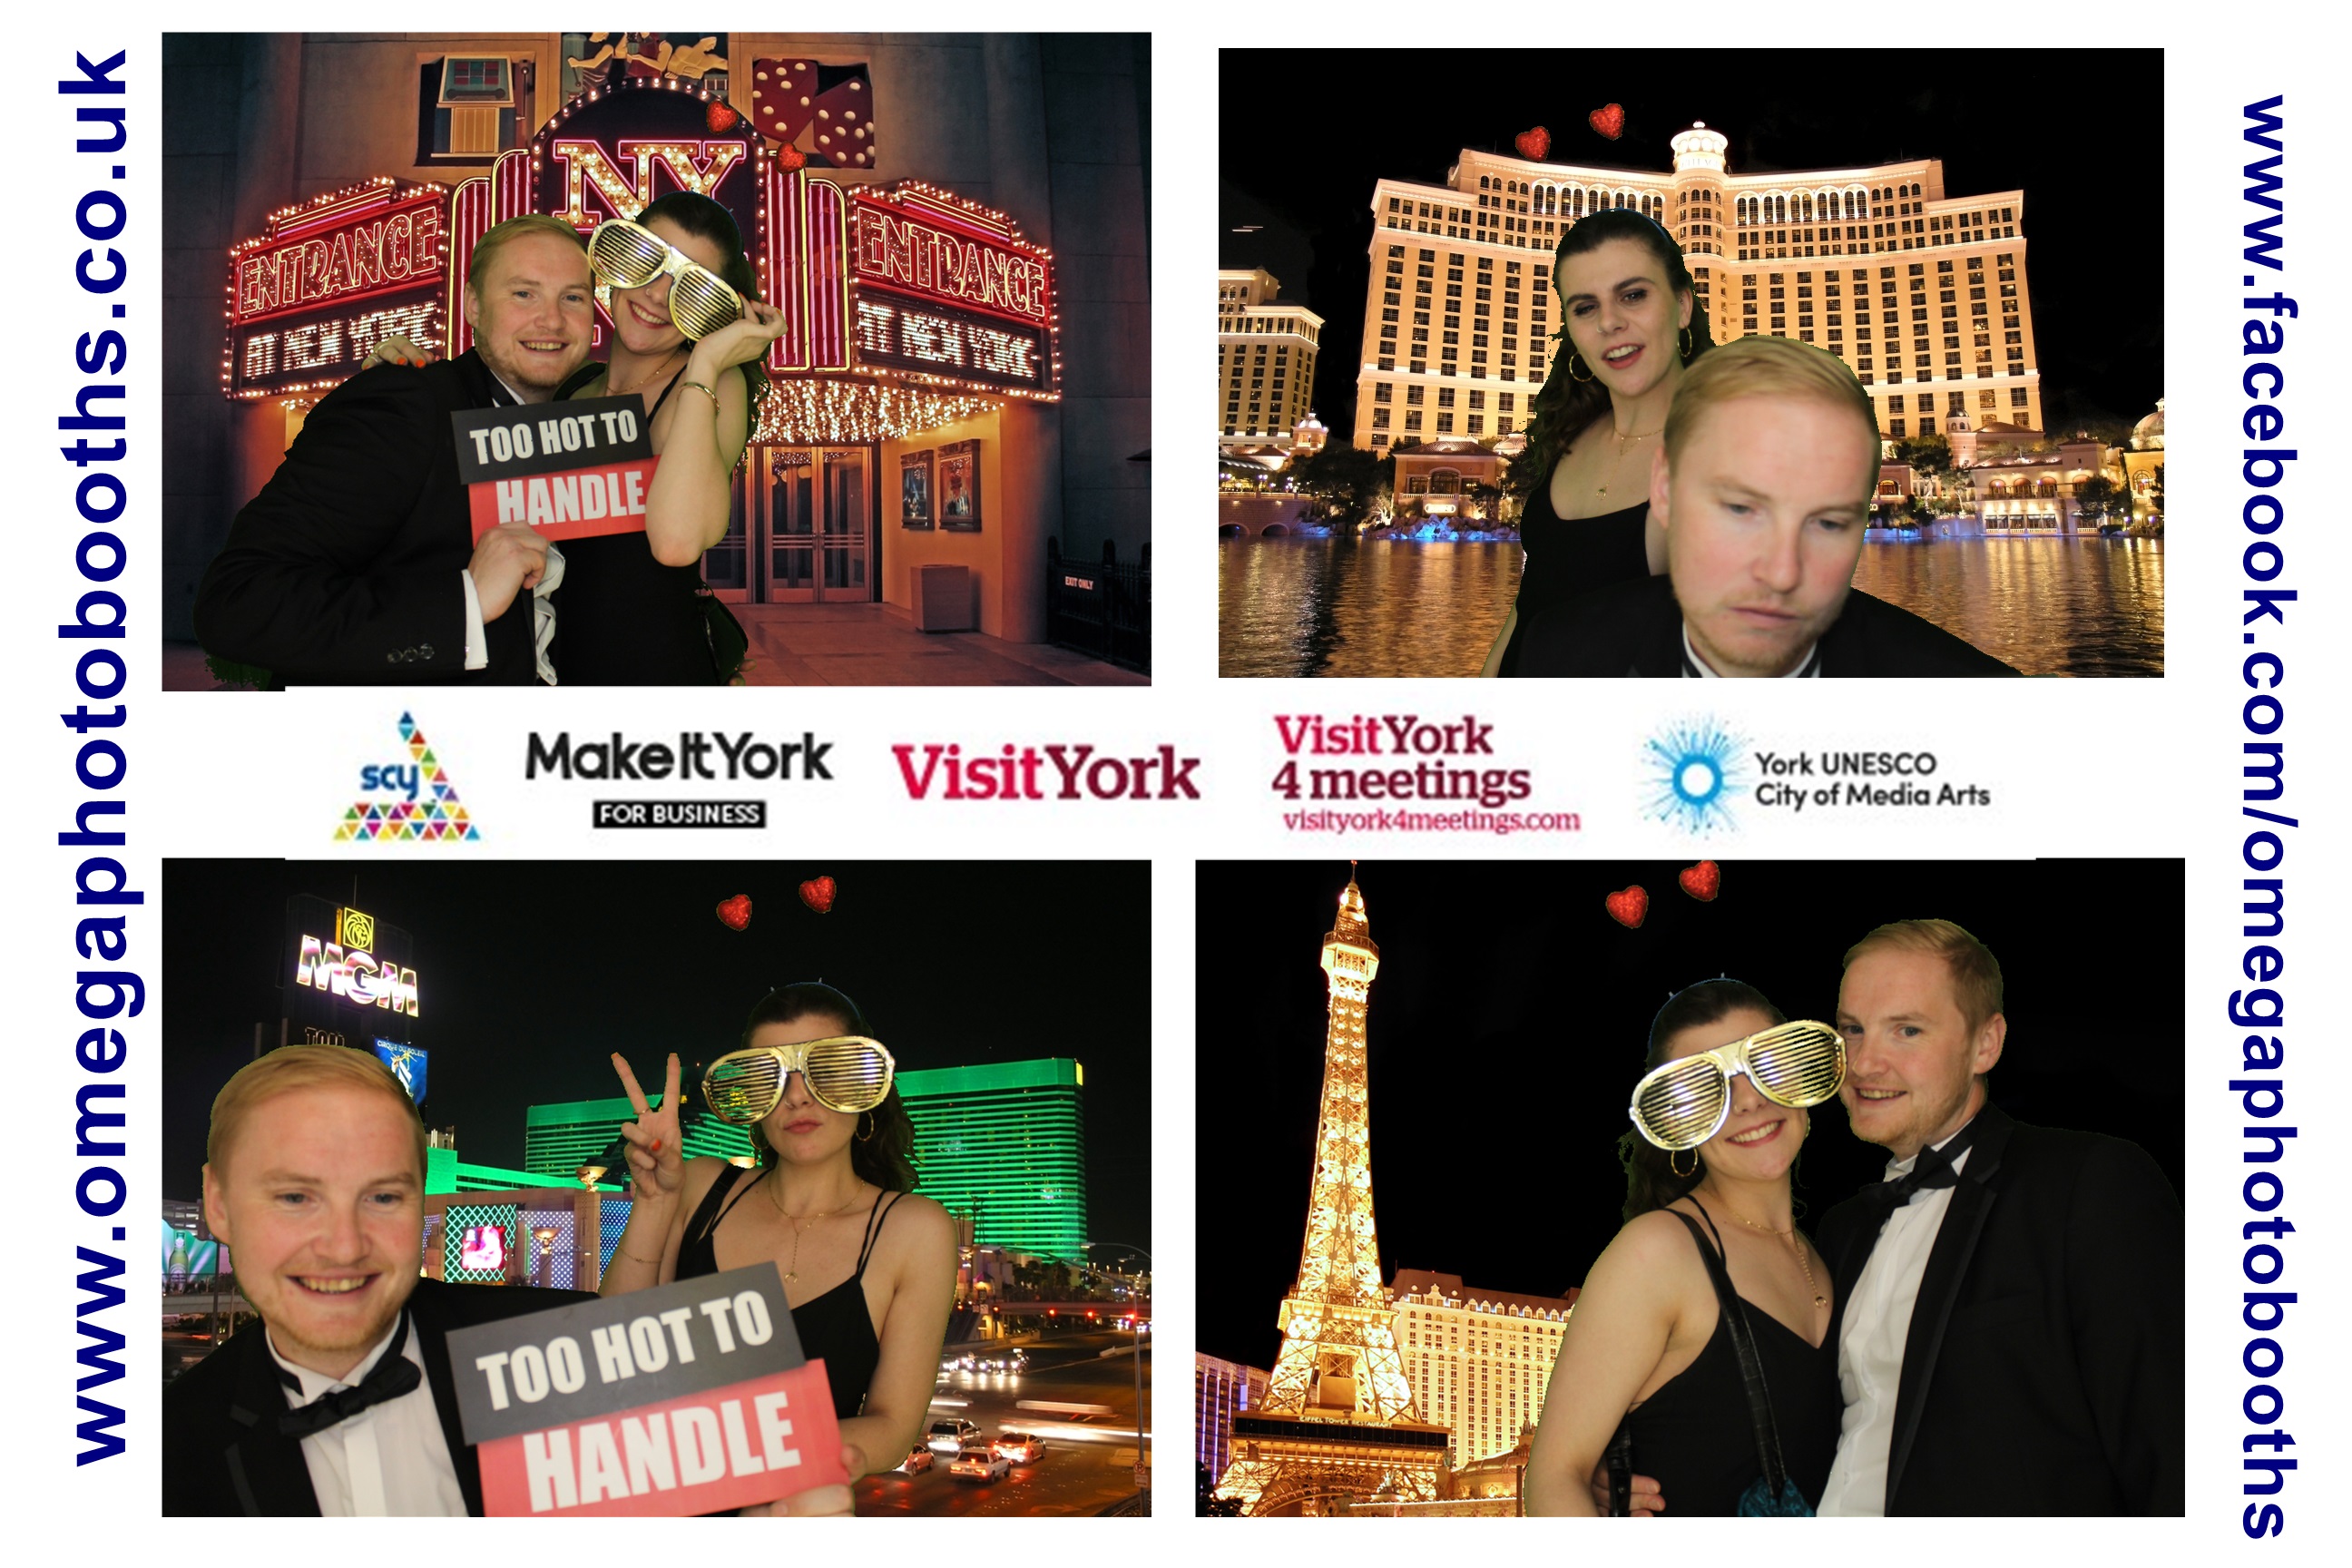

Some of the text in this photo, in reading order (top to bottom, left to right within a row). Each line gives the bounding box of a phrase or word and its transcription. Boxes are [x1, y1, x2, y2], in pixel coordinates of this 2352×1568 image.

[553, 140, 746, 231] NY
[238, 204, 438, 315] ENTRANCE
[857, 206, 1045, 317] ENTRANCE
[246, 333, 279, 378] AT
[901, 311, 965, 367] NEW
[469, 409, 638, 465] TOO HOT TO
[495, 471, 646, 525] HANDLE
[1078, 579, 1093, 590] ONLY
[297, 934, 418, 1017] MGM
[475, 1290, 773, 1411] TOO HOT TO
[523, 1391, 801, 1513] HANDLE
